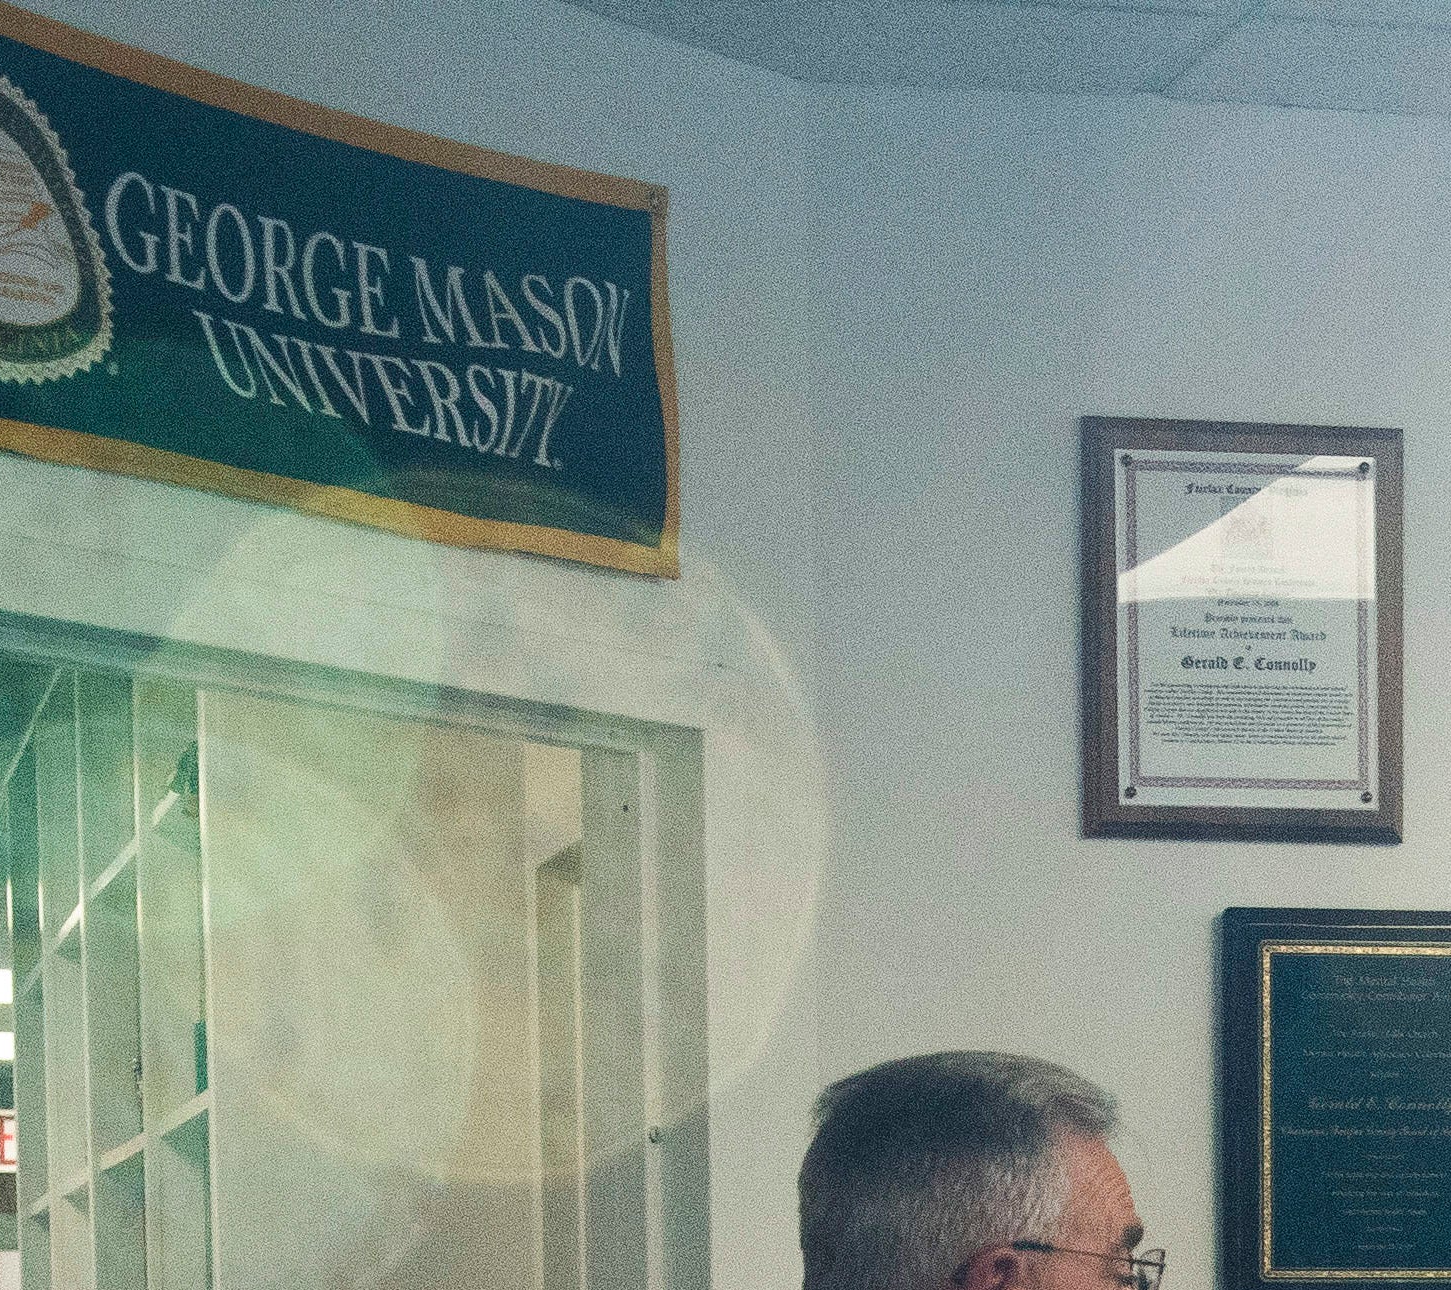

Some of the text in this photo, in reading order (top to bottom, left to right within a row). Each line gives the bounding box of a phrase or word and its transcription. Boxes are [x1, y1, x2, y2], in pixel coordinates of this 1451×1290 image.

[104, 171, 632, 378] GEORGE MASON
[191, 309, 556, 468] UNIVERSITY
[1181, 655, 1228, 671] Gerald
[1254, 657, 1317, 674] Connolly
